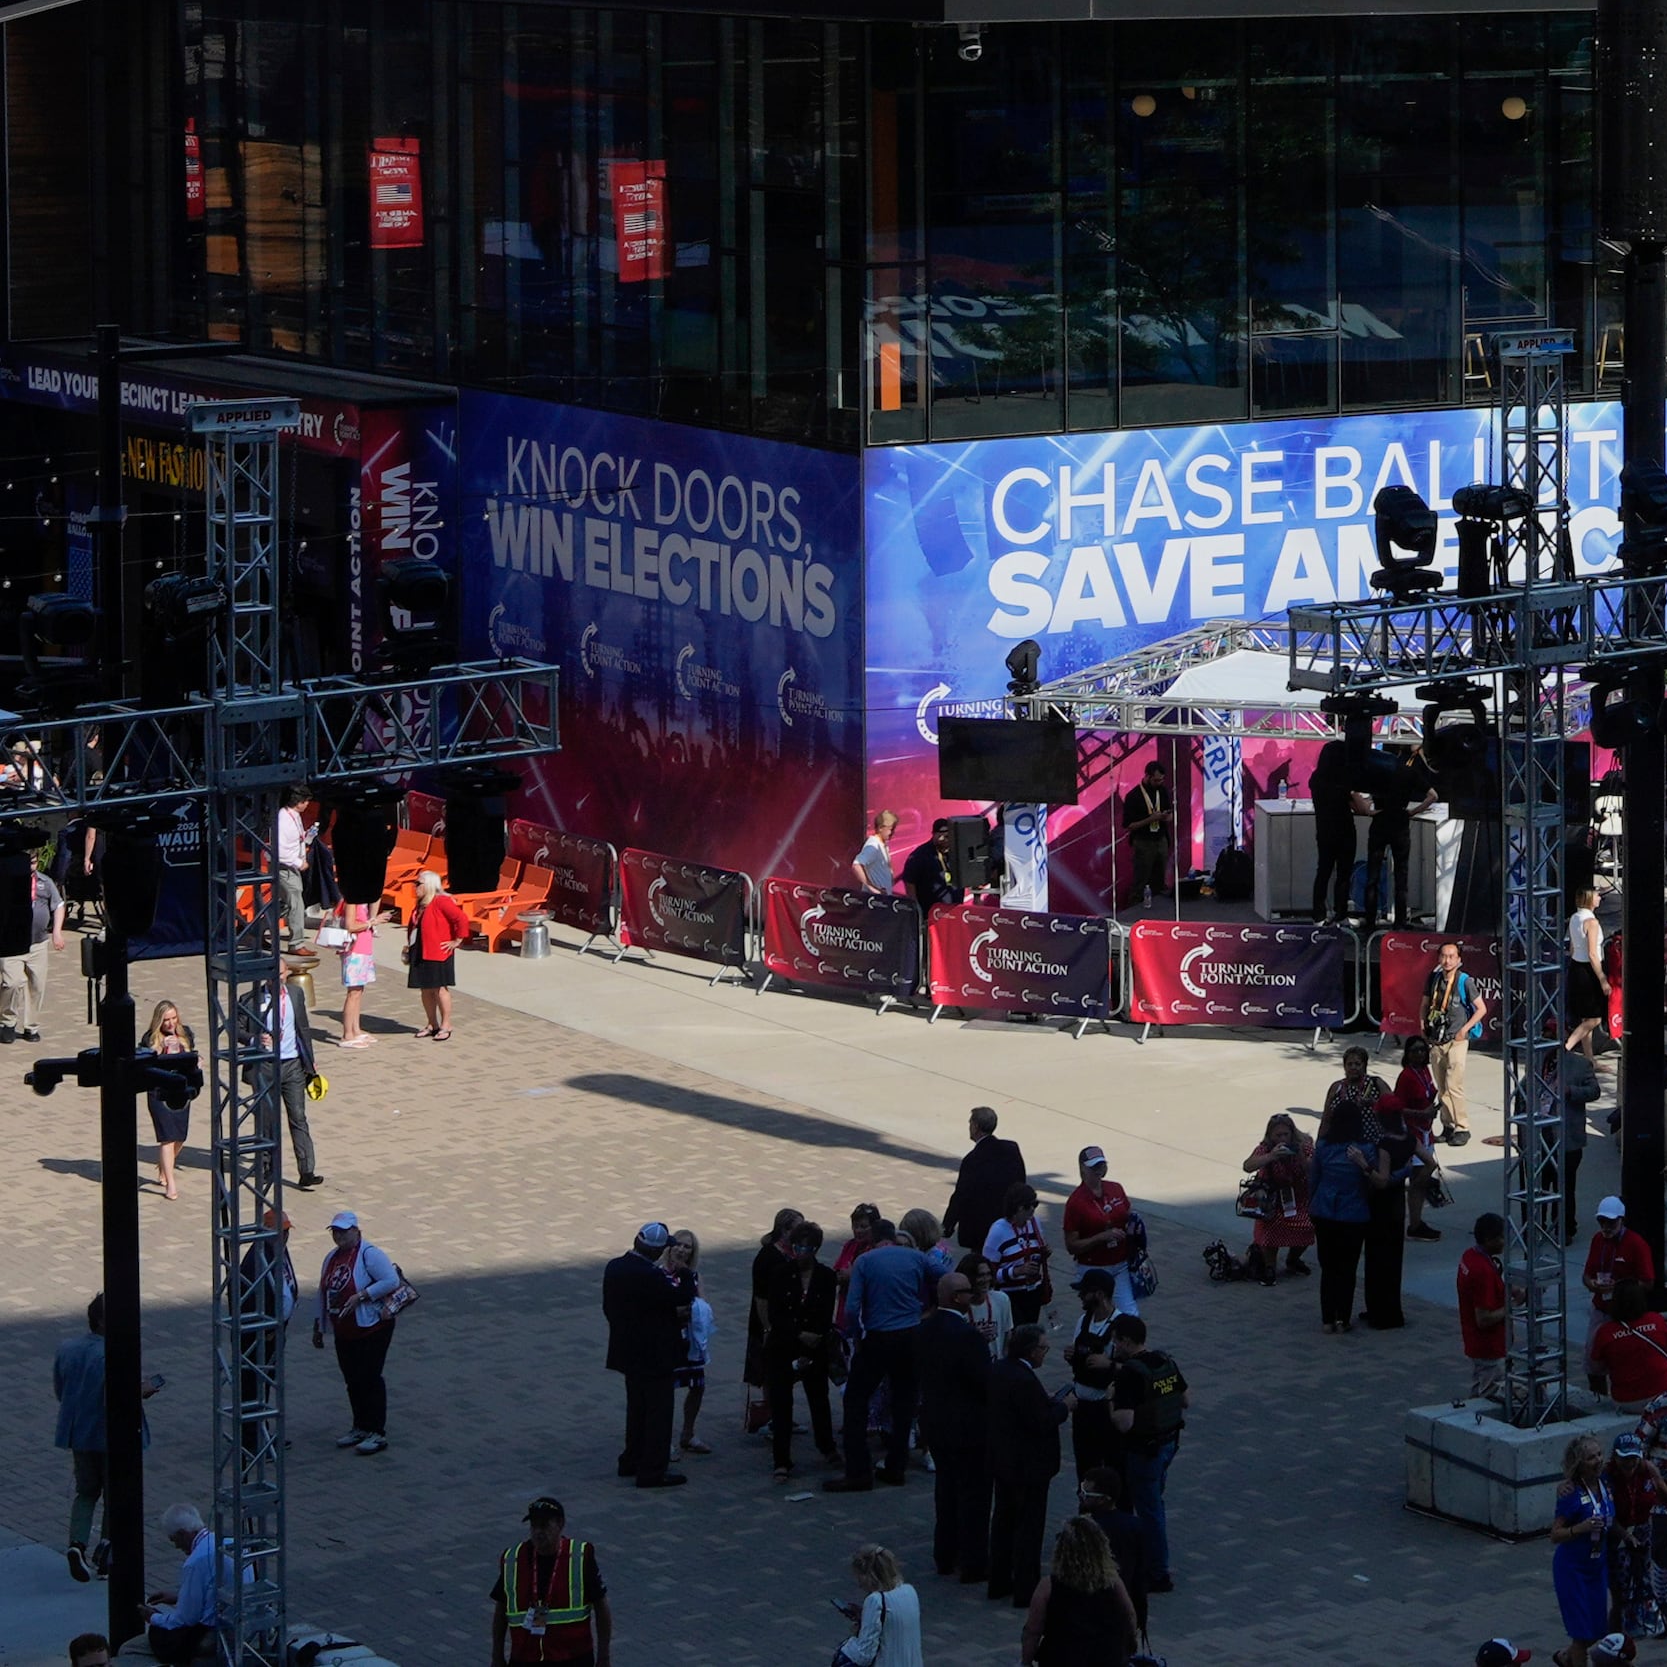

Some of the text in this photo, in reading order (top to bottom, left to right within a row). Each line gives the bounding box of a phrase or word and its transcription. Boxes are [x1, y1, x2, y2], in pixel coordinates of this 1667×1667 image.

[27, 365, 62, 394] LEAD
[120, 382, 168, 413] ECINCT
[217, 410, 271, 424] APPLIED
[127, 435, 156, 482] NEW
[381, 462, 411, 549] WIN
[507, 436, 813, 566] KNOCK DOORS,
[990, 450, 1284, 546] CHASE
[485, 498, 836, 638] WIN ELECTIONS
[350, 487, 363, 673] OINT ACTION
[986, 533, 1246, 640] SAVE
[938, 700, 1004, 718] TURNING
[562, 878, 589, 894] ACTION
[660, 893, 698, 911] TURNING
[660, 902, 715, 925] POINT ACTION
[812, 922, 860, 940] TURNING
[814, 933, 883, 953] POINT ACTION
[987, 947, 1041, 964] TURNING
[987, 958, 1069, 976] POINT ACTION
[1200, 962, 1264, 976] TURNING
[1200, 974, 1297, 988] POINT ACTION
[1153, 1374, 1178, 1390] POLICE
